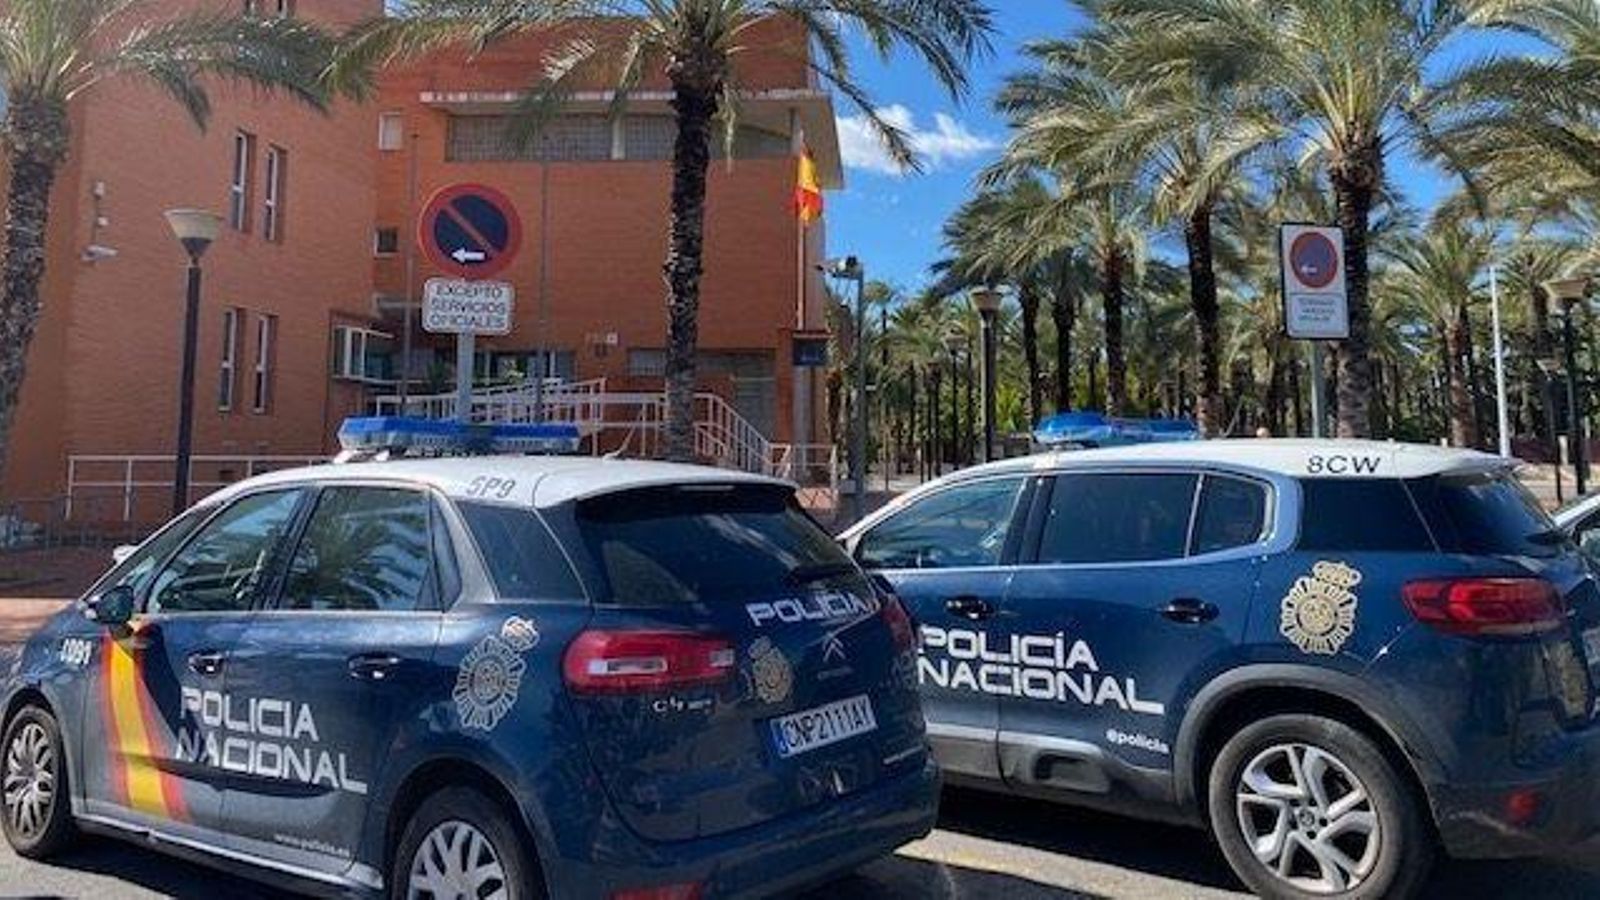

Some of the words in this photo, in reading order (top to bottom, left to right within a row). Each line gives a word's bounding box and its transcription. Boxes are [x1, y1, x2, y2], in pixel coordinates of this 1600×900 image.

[431, 298, 506, 315] SERVICIOS
[436, 284, 503, 299] EXCEPTO
[431, 314, 505, 328] OFICIALES
[1307, 455, 1381, 474] 8CW
[918, 624, 1099, 672] POLICÍA
[917, 656, 1165, 715] NACIONAL
[181, 686, 319, 742] POLICIA
[782, 698, 873, 748] CNP2111AY
[1106, 729, 1169, 755] @policia
[175, 729, 368, 795] NACIONAL
